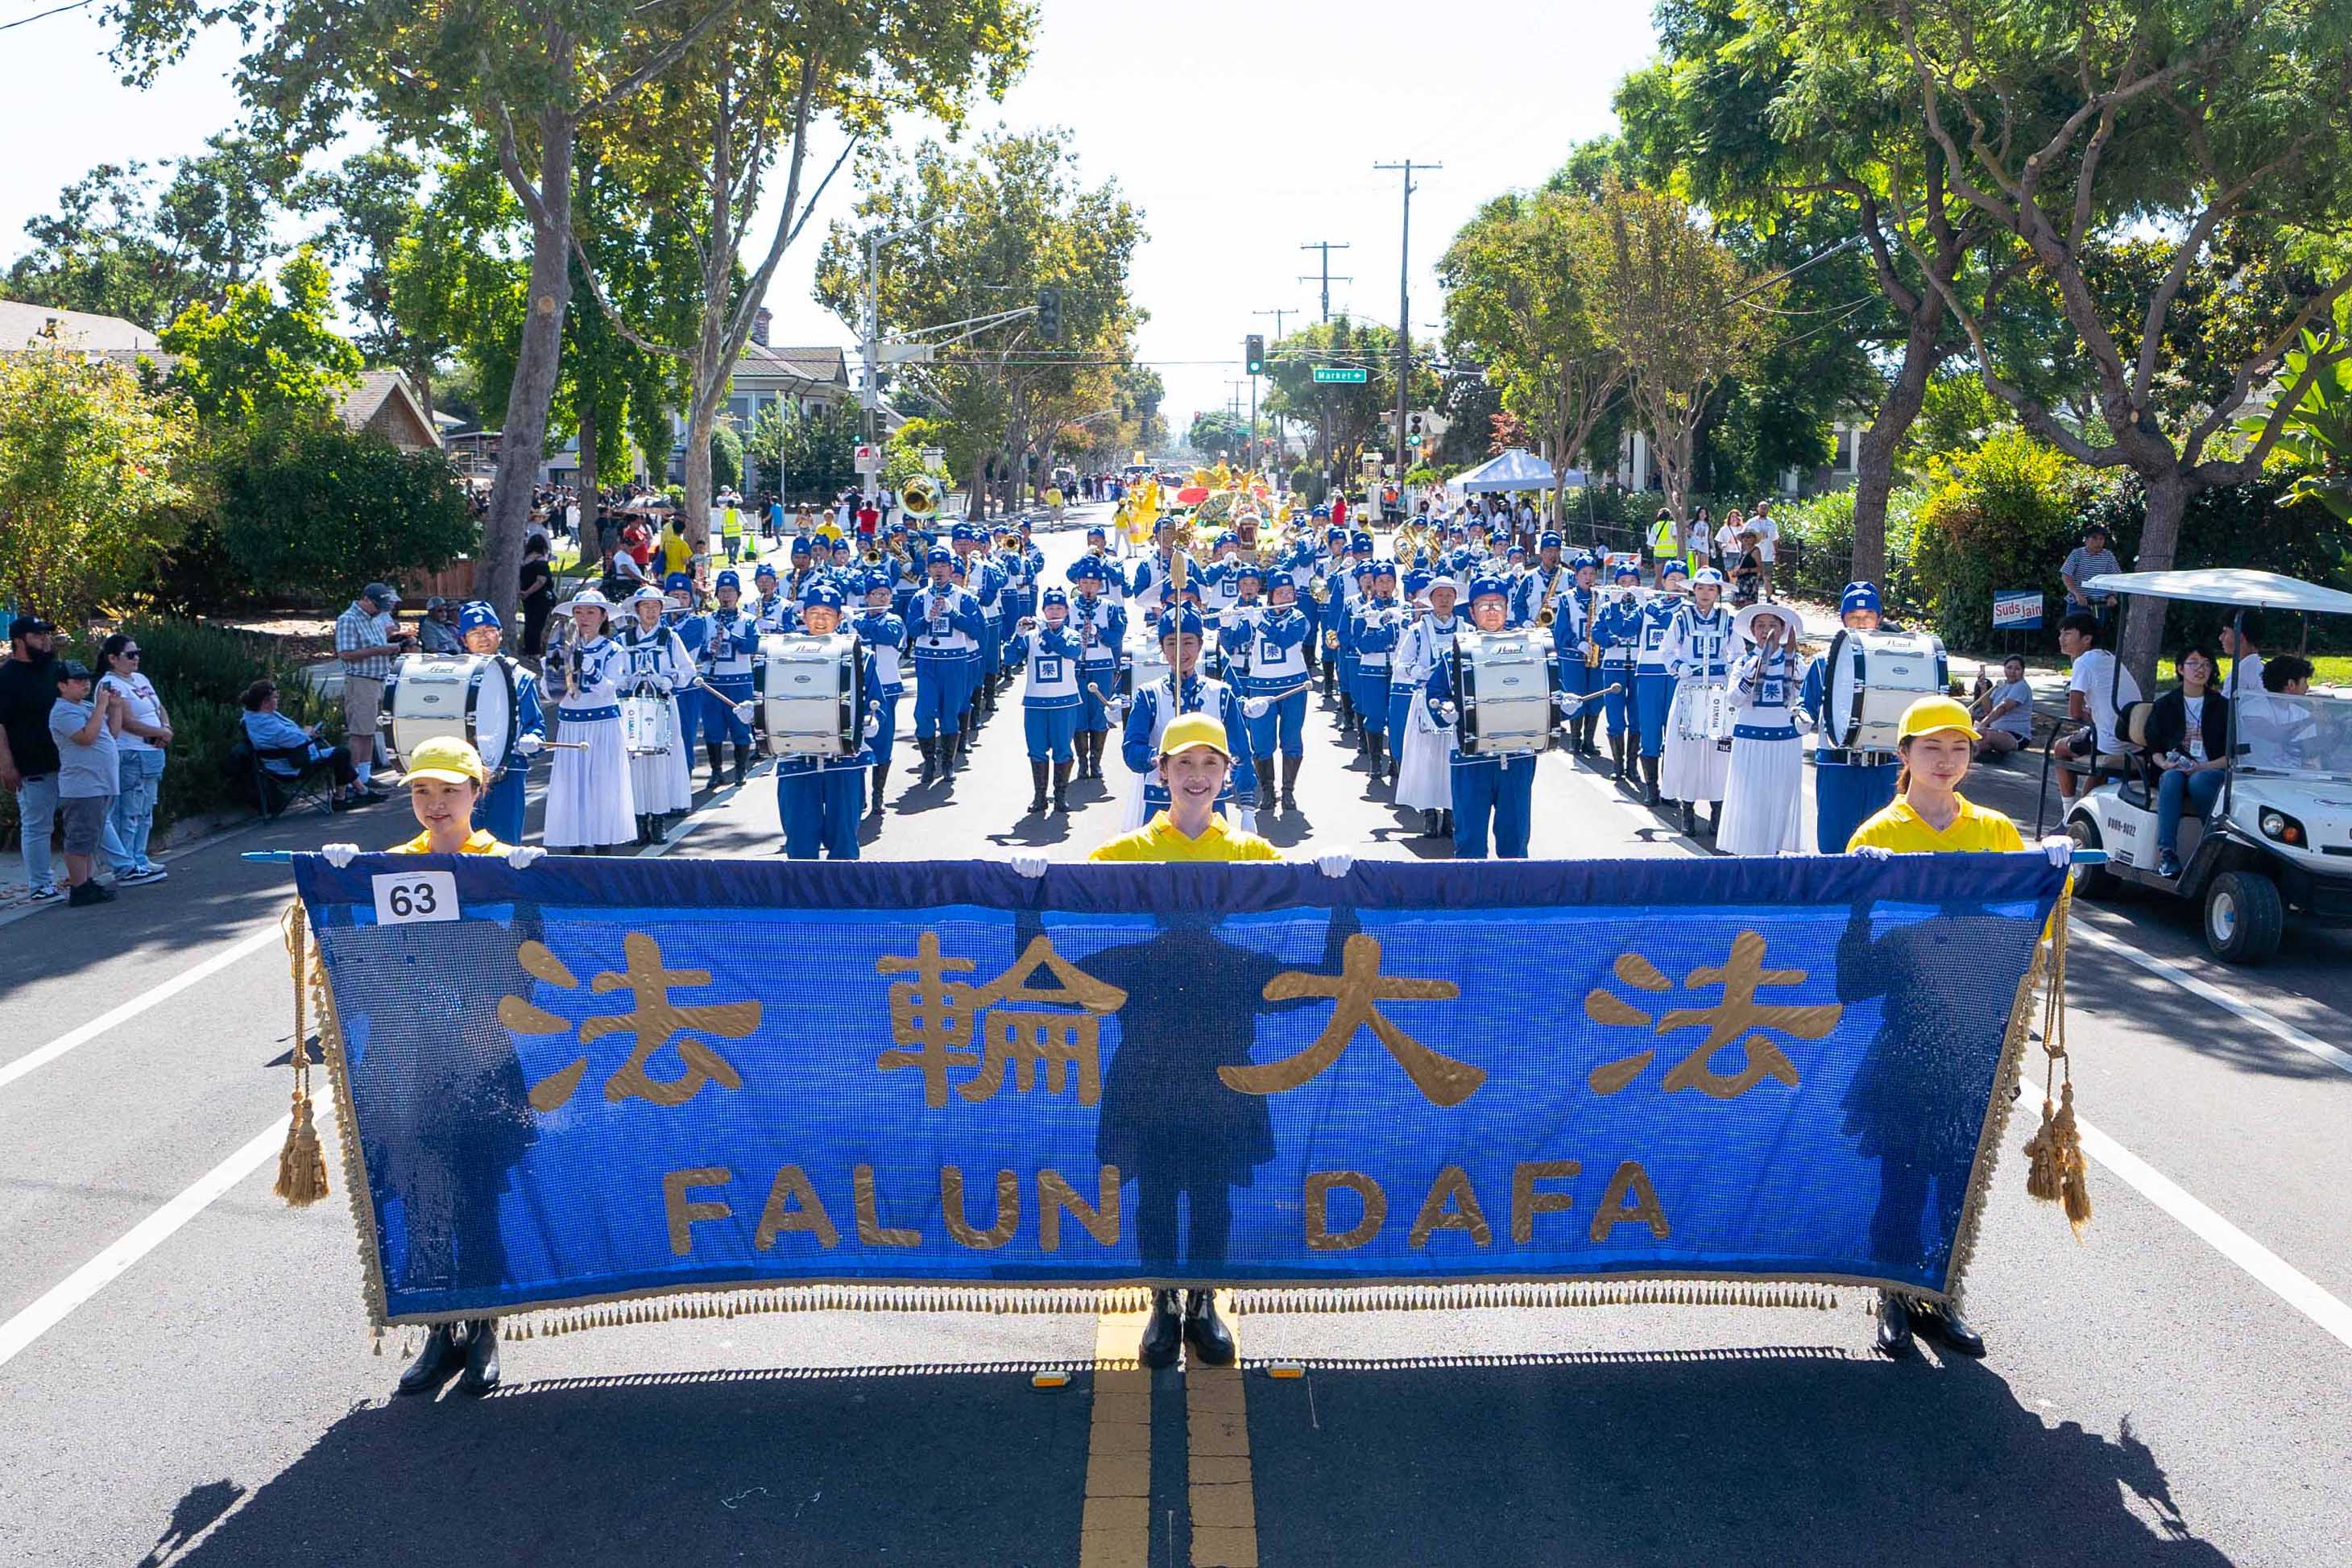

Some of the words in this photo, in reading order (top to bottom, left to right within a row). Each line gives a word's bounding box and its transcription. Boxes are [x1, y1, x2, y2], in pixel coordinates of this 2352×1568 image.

[1319, 371, 1351, 379] Market
[1995, 602, 2021, 617] Suds
[2022, 604, 2042, 618] Jain
[390, 883, 437, 916] 63
[662, 1165, 1121, 1256] FALUN
[1305, 1161, 1671, 1250] DAFA
